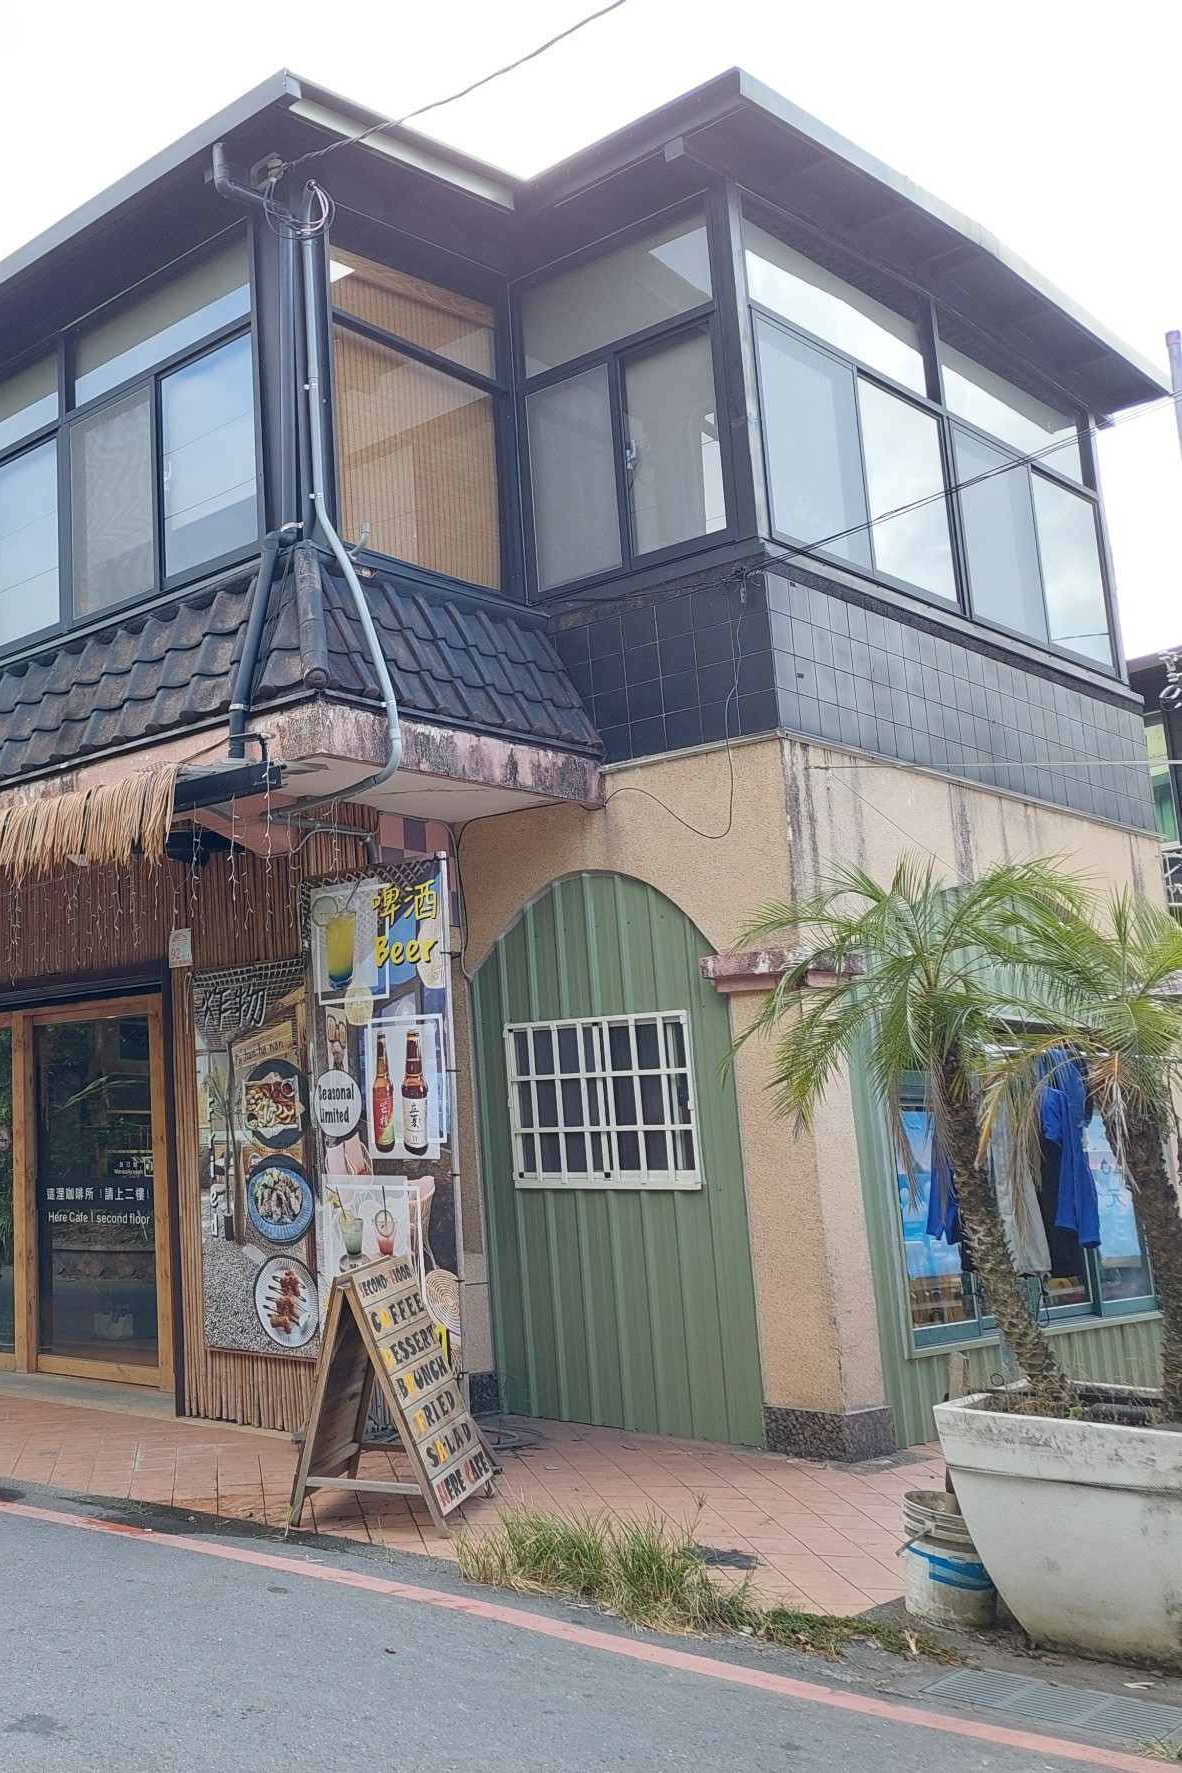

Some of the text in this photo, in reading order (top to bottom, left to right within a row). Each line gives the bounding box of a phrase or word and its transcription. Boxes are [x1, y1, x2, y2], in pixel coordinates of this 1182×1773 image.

[371, 879, 437, 925] 啤酒
[375, 935, 438, 967] Beer
[201, 984, 267, 1030] 炸物
[318, 1083, 354, 1100] Seasonal
[320, 1106, 350, 1124] Limited
[104, 1187, 145, 1201] 請上二樓
[48, 1211, 151, 1225] Here Cafe second floor
[371, 1292, 425, 1333] COFFEE
[396, 1355, 448, 1400] BRUNCH
[414, 1390, 456, 1434] FRIED
[426, 1422, 472, 1468] SALAD
[436, 1451, 490, 1507] HERE CAFE
